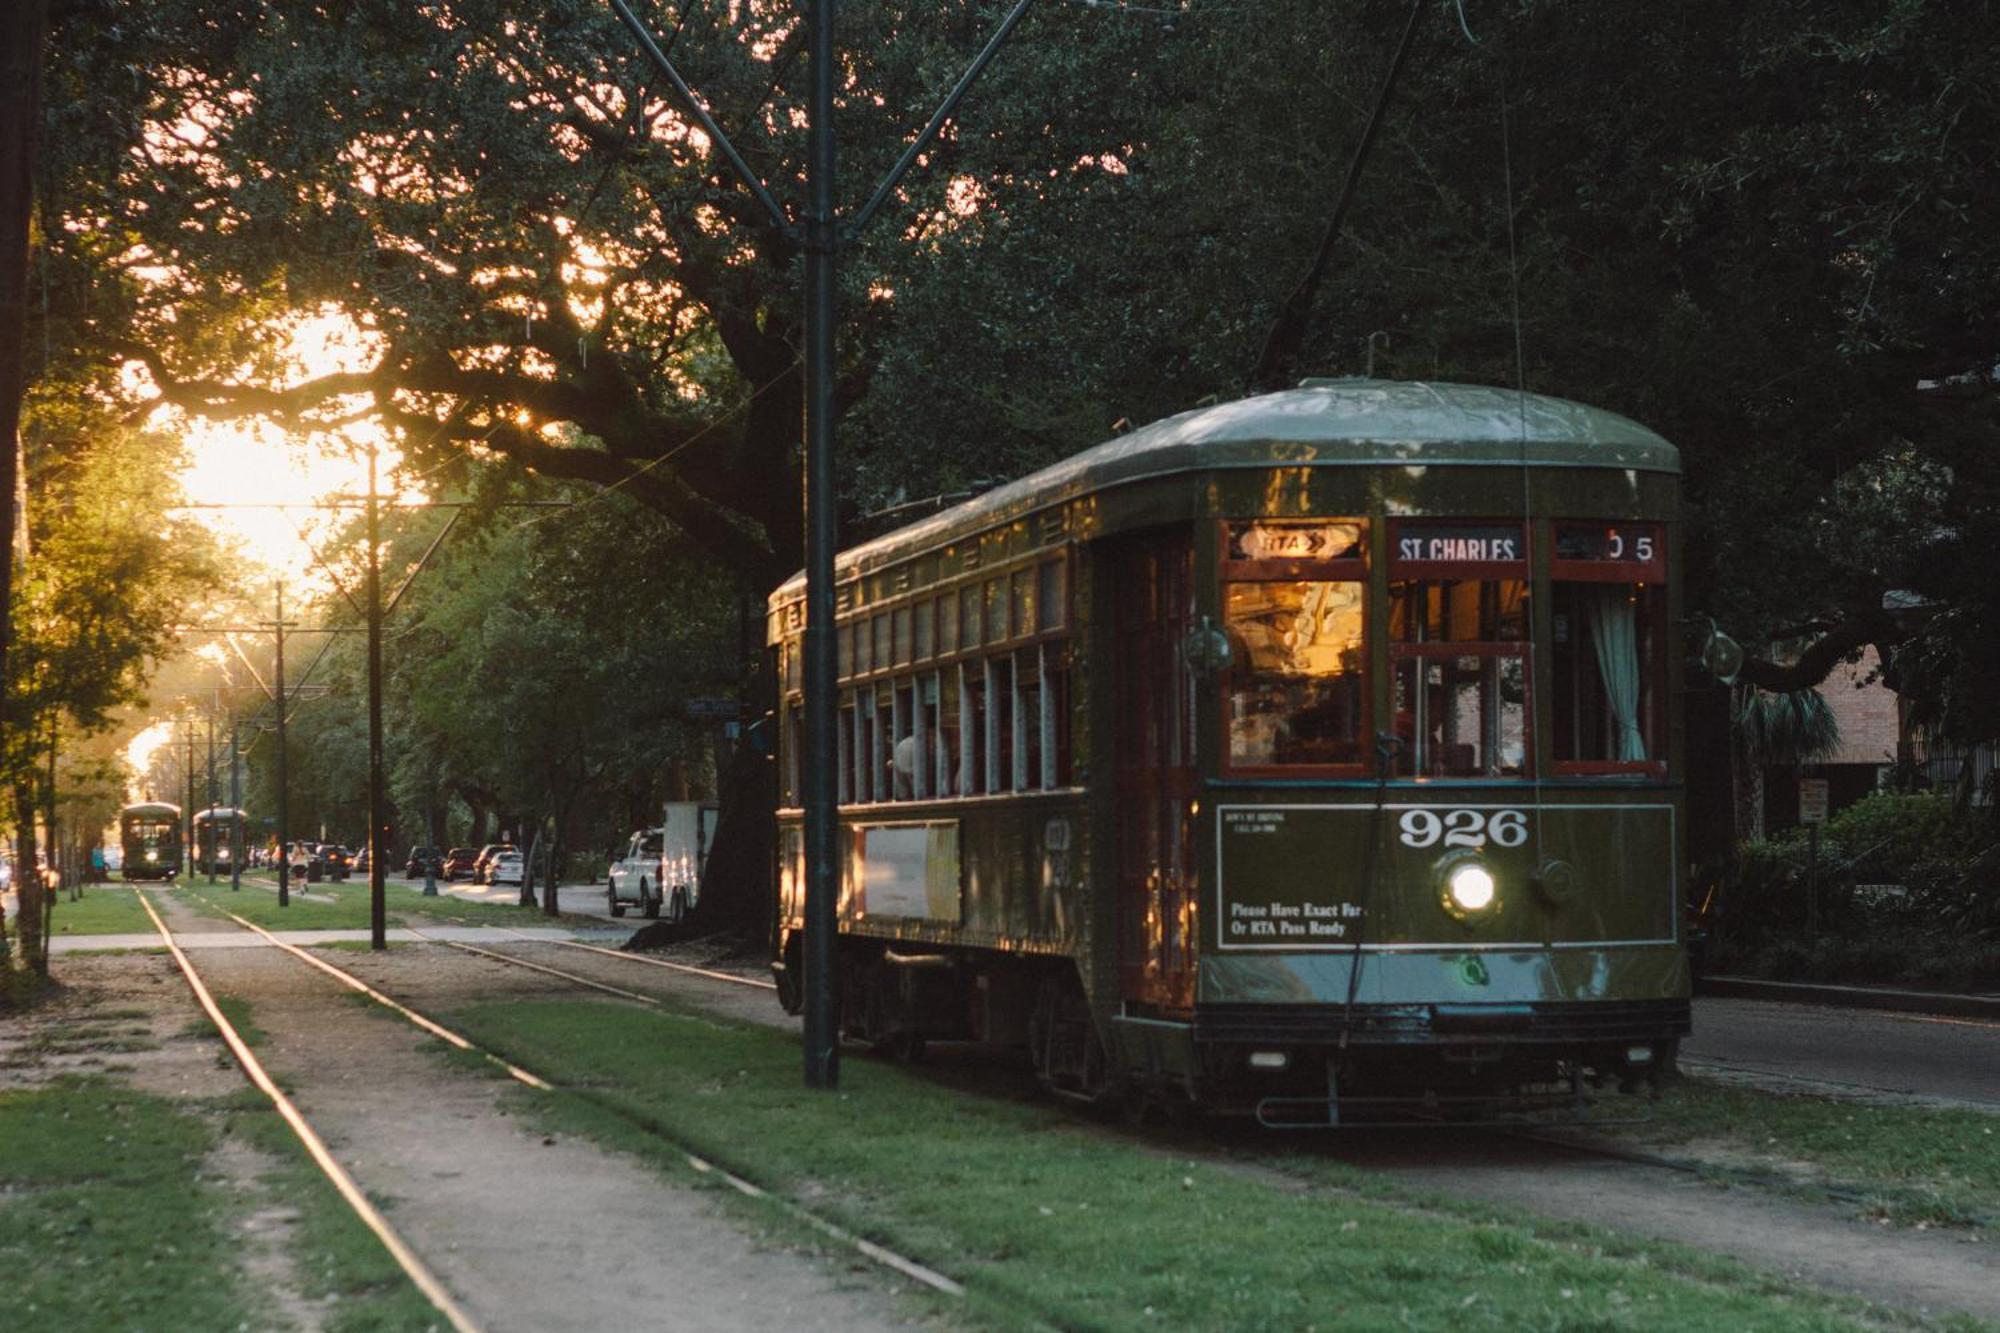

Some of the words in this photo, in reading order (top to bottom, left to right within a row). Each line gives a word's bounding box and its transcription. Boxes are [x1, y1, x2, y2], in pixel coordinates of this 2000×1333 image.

[1429, 538, 1515, 560] CHARLES
[1399, 809, 1528, 848] 926
[1231, 902, 1267, 917] Please
[1271, 902, 1300, 917] Have
[1303, 902, 1339, 917] Exact
[1342, 902, 1368, 917] Far
[1231, 921, 1247, 935] Or
[1250, 921, 1277, 935] RTA
[1279, 921, 1306, 935] Pass
[1309, 921, 1346, 937] Ready
